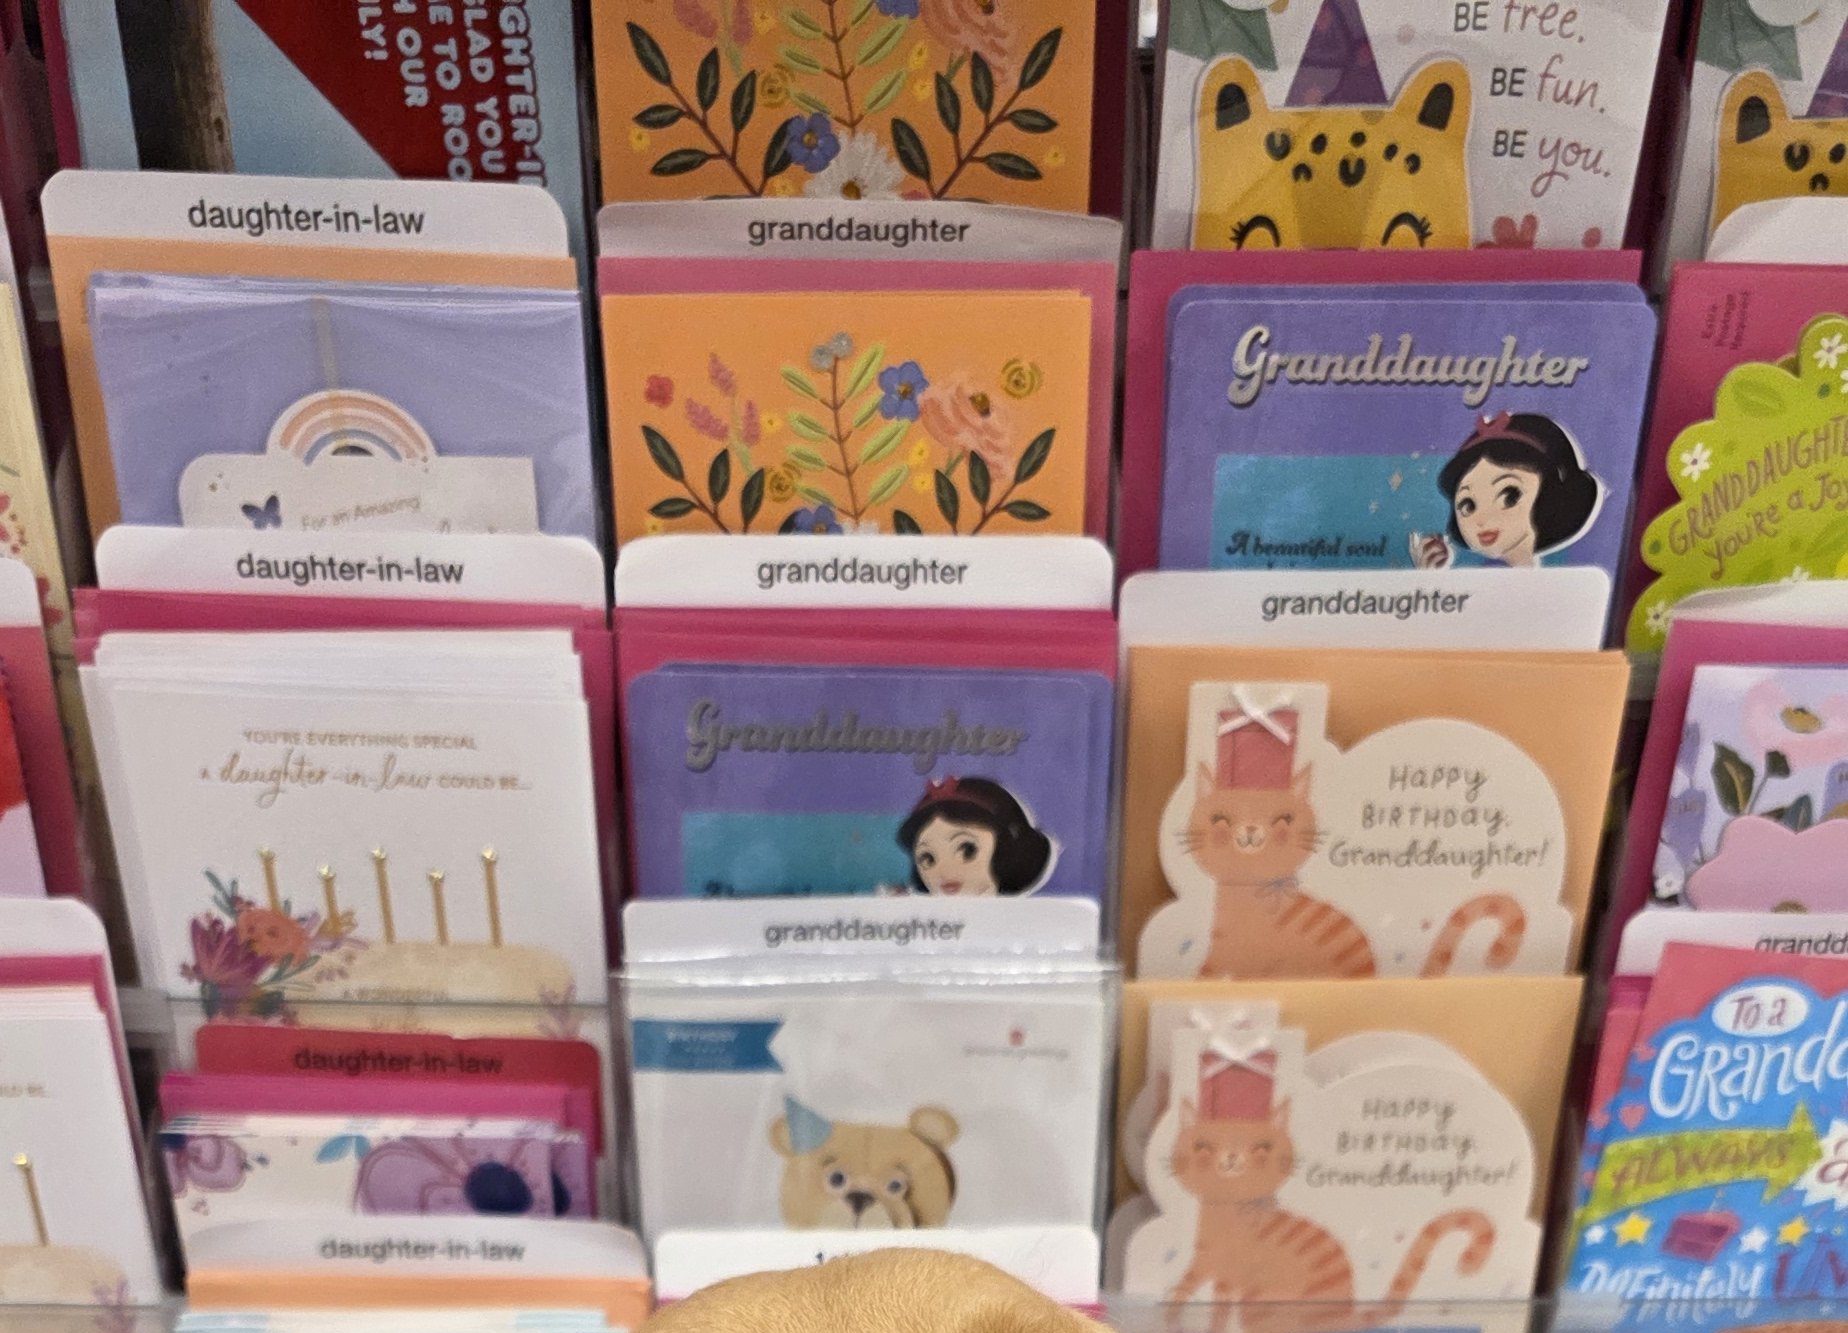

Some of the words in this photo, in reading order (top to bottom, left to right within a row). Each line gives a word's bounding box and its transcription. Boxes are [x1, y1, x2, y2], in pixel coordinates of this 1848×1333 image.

[358, 0, 389, 60] LY!
[1453, 1, 1489, 32] BE
[432, 38, 461, 90] TO
[462, 0, 491, 83] LAD
[396, 27, 428, 107] OUR
[1490, 67, 1527, 97] BE
[1537, 53, 1605, 113] fun.
[498, 0, 545, 185] GHTER-I
[440, 104, 473, 182] ROO
[474, 97, 506, 173] YOU
[1492, 130, 1528, 158] BE
[1530, 137, 1611, 198] you.
[187, 199, 425, 237] daughter-in-law
[747, 216, 971, 248] granddaughter
[1226, 323, 1589, 408] Granddaughter
[236, 553, 465, 587] daughter-in-law
[756, 557, 968, 591] granddaughter
[1260, 589, 1471, 619] granddaughter
[685, 700, 1029, 773] Granddaughter
[763, 918, 966, 948] granddaughter
[1754, 932, 1848, 955] grandd
[1731, 996, 1762, 1030] To
[294, 1046, 504, 1077] daughter-in-law
[319, 1233, 525, 1264] daughter-in-law
